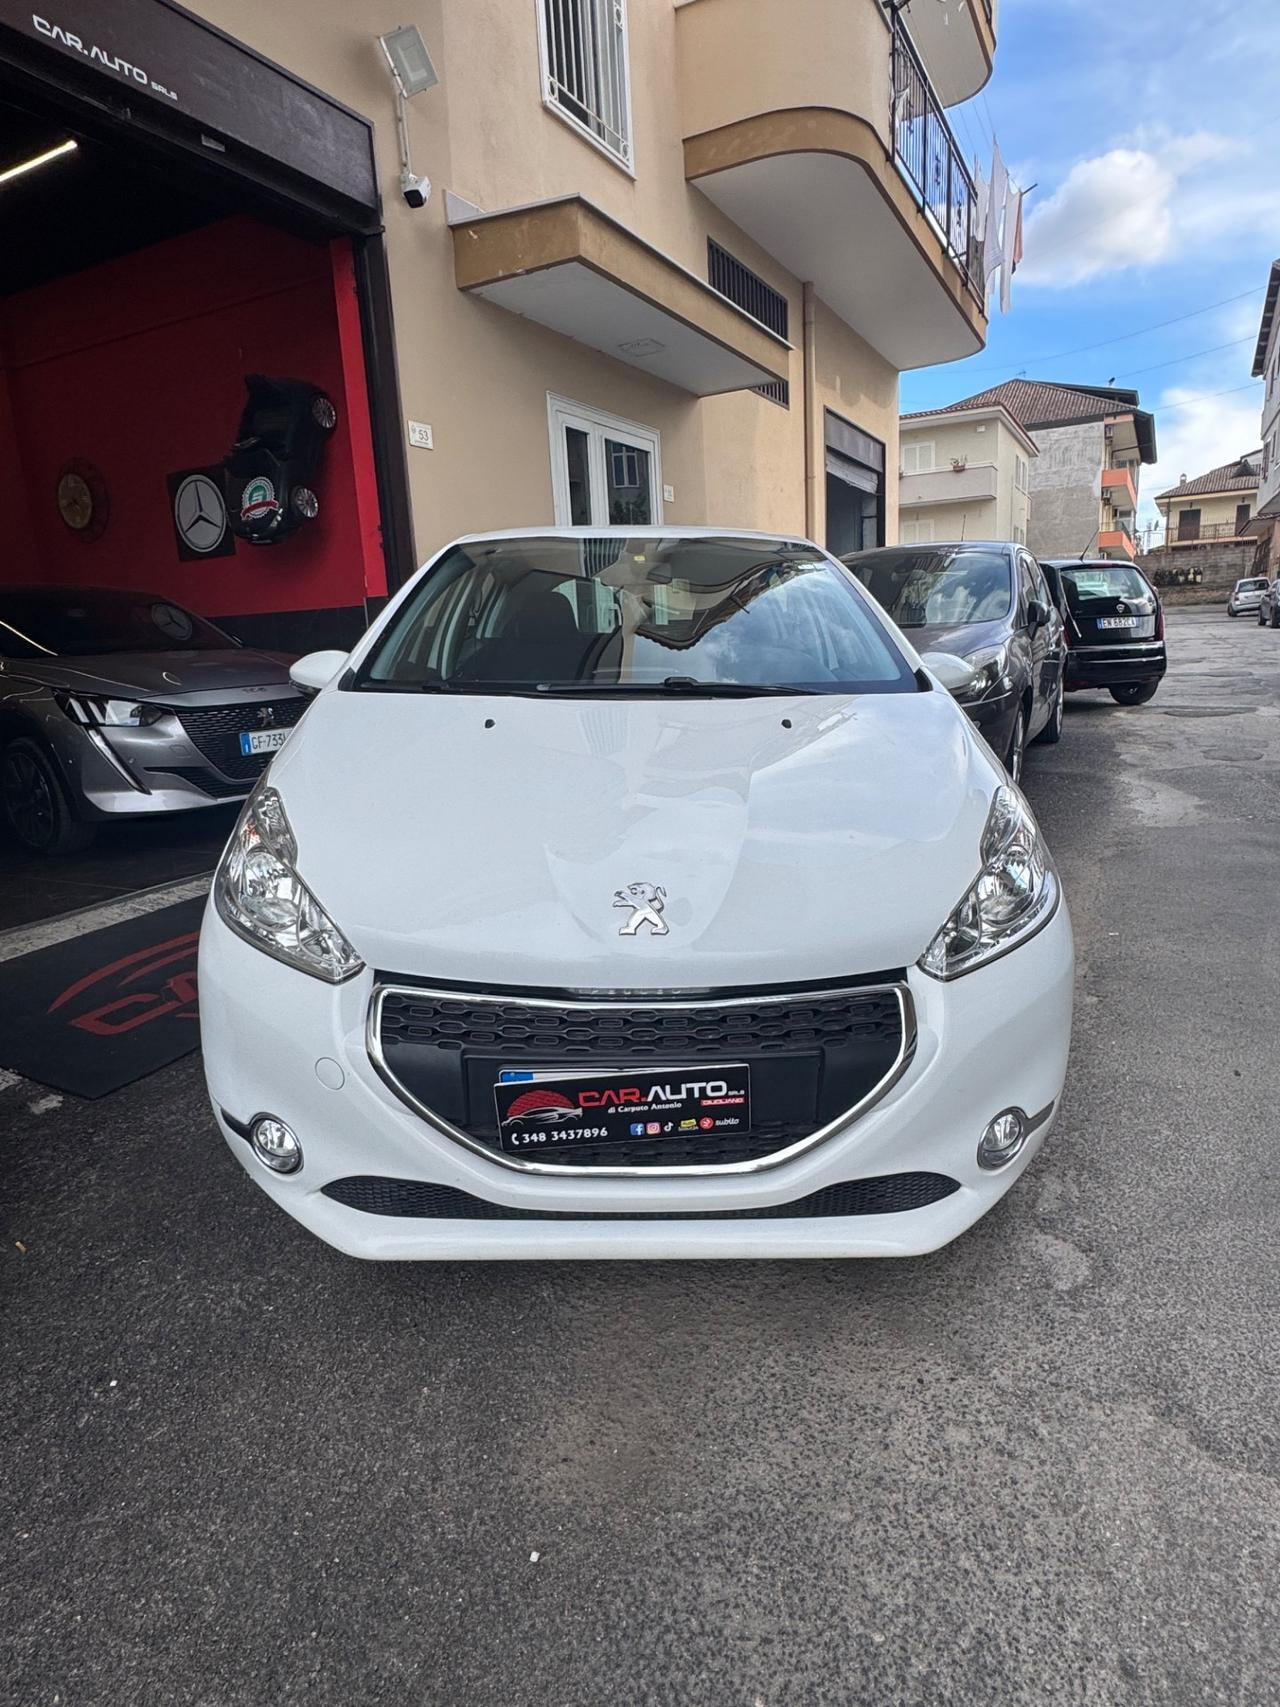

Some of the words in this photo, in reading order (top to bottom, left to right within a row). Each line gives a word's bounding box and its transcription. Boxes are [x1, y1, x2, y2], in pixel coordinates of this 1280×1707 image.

[32, 14, 149, 85] CAR.AUTO
[418, 429, 429, 441] 53
[608, 1106, 616, 1114] di
[651, 1101, 682, 1110] Antonio
[715, 1117, 740, 1126] subito
[522, 1132, 546, 1143] 348
[551, 1127, 608, 1141] 3437896
